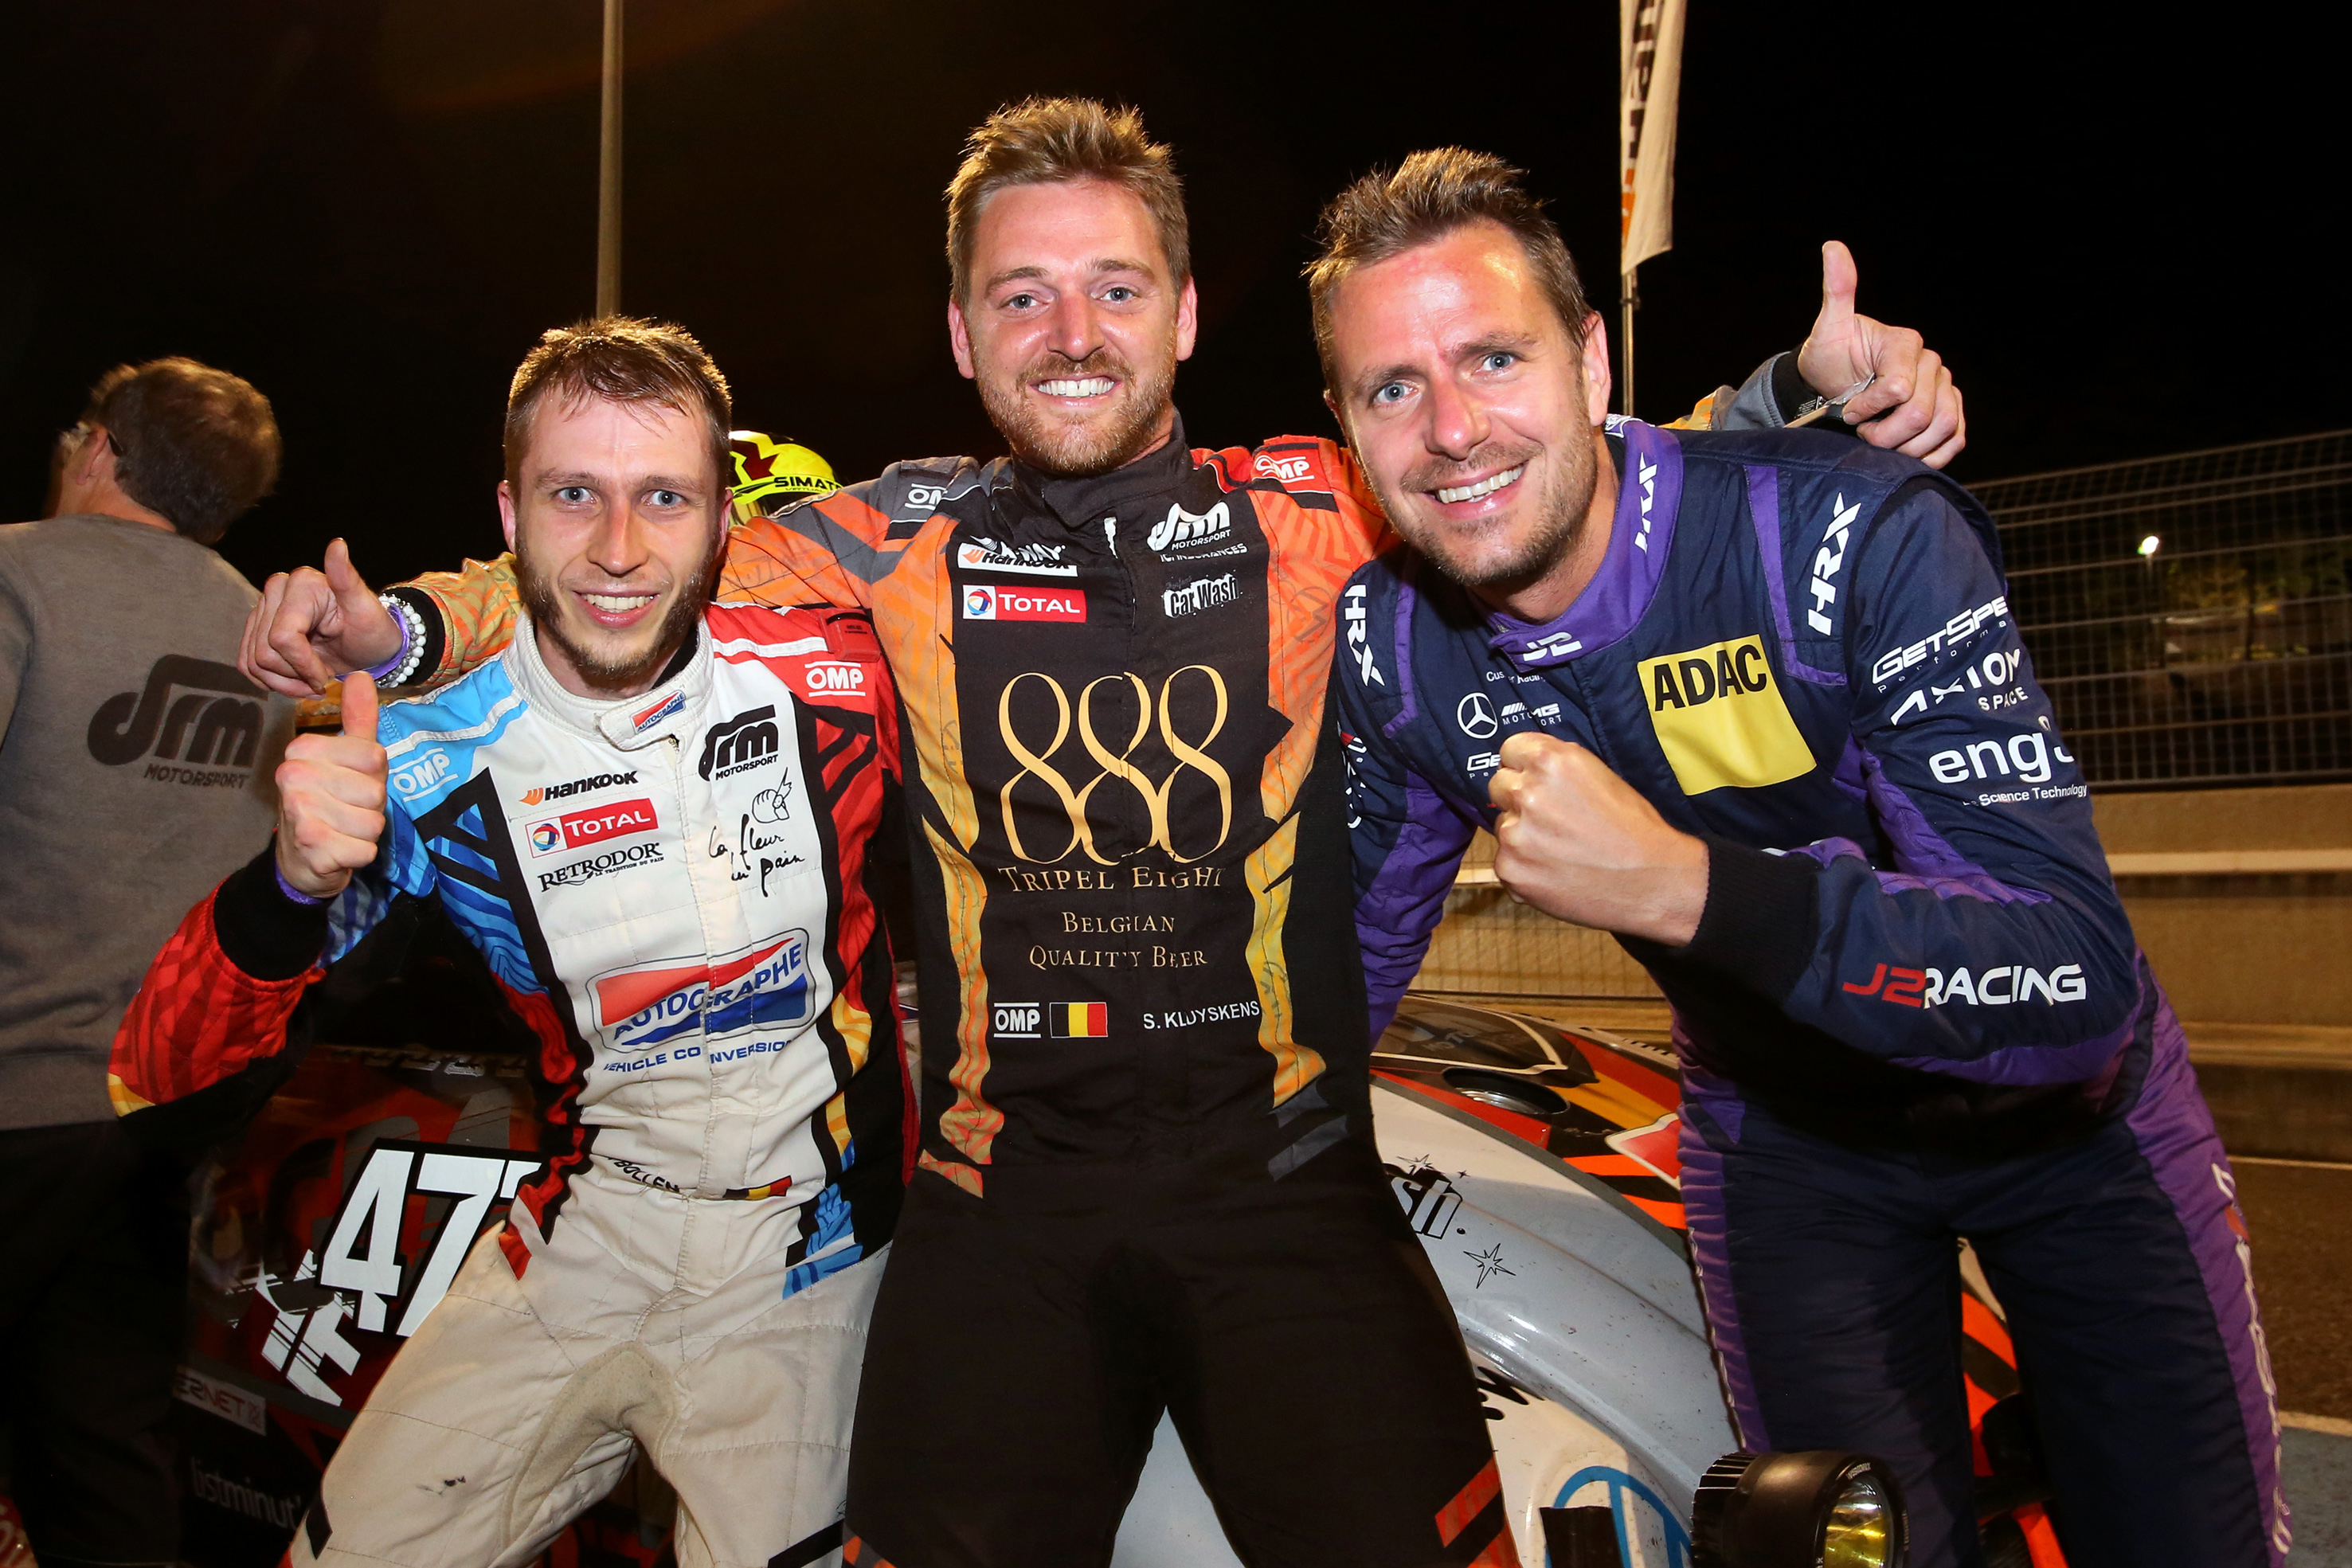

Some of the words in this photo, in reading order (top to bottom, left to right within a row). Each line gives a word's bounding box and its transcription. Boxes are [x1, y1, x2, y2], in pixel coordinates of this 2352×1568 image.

[1256, 458, 1310, 479] OMP
[908, 487, 945, 506] OM
[1172, 529, 1231, 551] MOTORSPORT
[1808, 491, 1861, 636] HRX
[998, 593, 1081, 613] TOTAL
[1169, 592, 1195, 618] Car
[1196, 576, 1239, 610] Wash
[1344, 585, 1384, 686] HRX
[1873, 595, 2009, 684] GETSPE
[805, 666, 865, 690] OMP
[1653, 643, 1767, 712] ADAC
[1977, 686, 2029, 711] SPACE
[636, 693, 685, 733] AUTOGRAPHE
[143, 763, 249, 790] MOTORSPORT
[393, 753, 451, 794] OMP
[716, 753, 779, 781] MOTORSPORT
[998, 663, 1232, 866] 888
[1978, 791, 2030, 807] Science
[2031, 784, 2088, 800] Technology
[564, 810, 652, 837] TOTAL
[538, 842, 663, 893] RETRODOR
[605, 863, 637, 874] TRADITION
[998, 866, 1115, 892] TRIPEL
[1131, 866, 1226, 889] EIGHT
[1062, 911, 1176, 933] BELGIAN
[1028, 944, 1141, 971] QUALITY
[1152, 945, 1208, 968] BEER
[613, 943, 802, 1040] AUTOGRAPHE
[995, 1008, 1041, 1032] OMP
[1143, 1012, 1161, 1030] S.
[604, 1053, 668, 1073] VEHICLE
